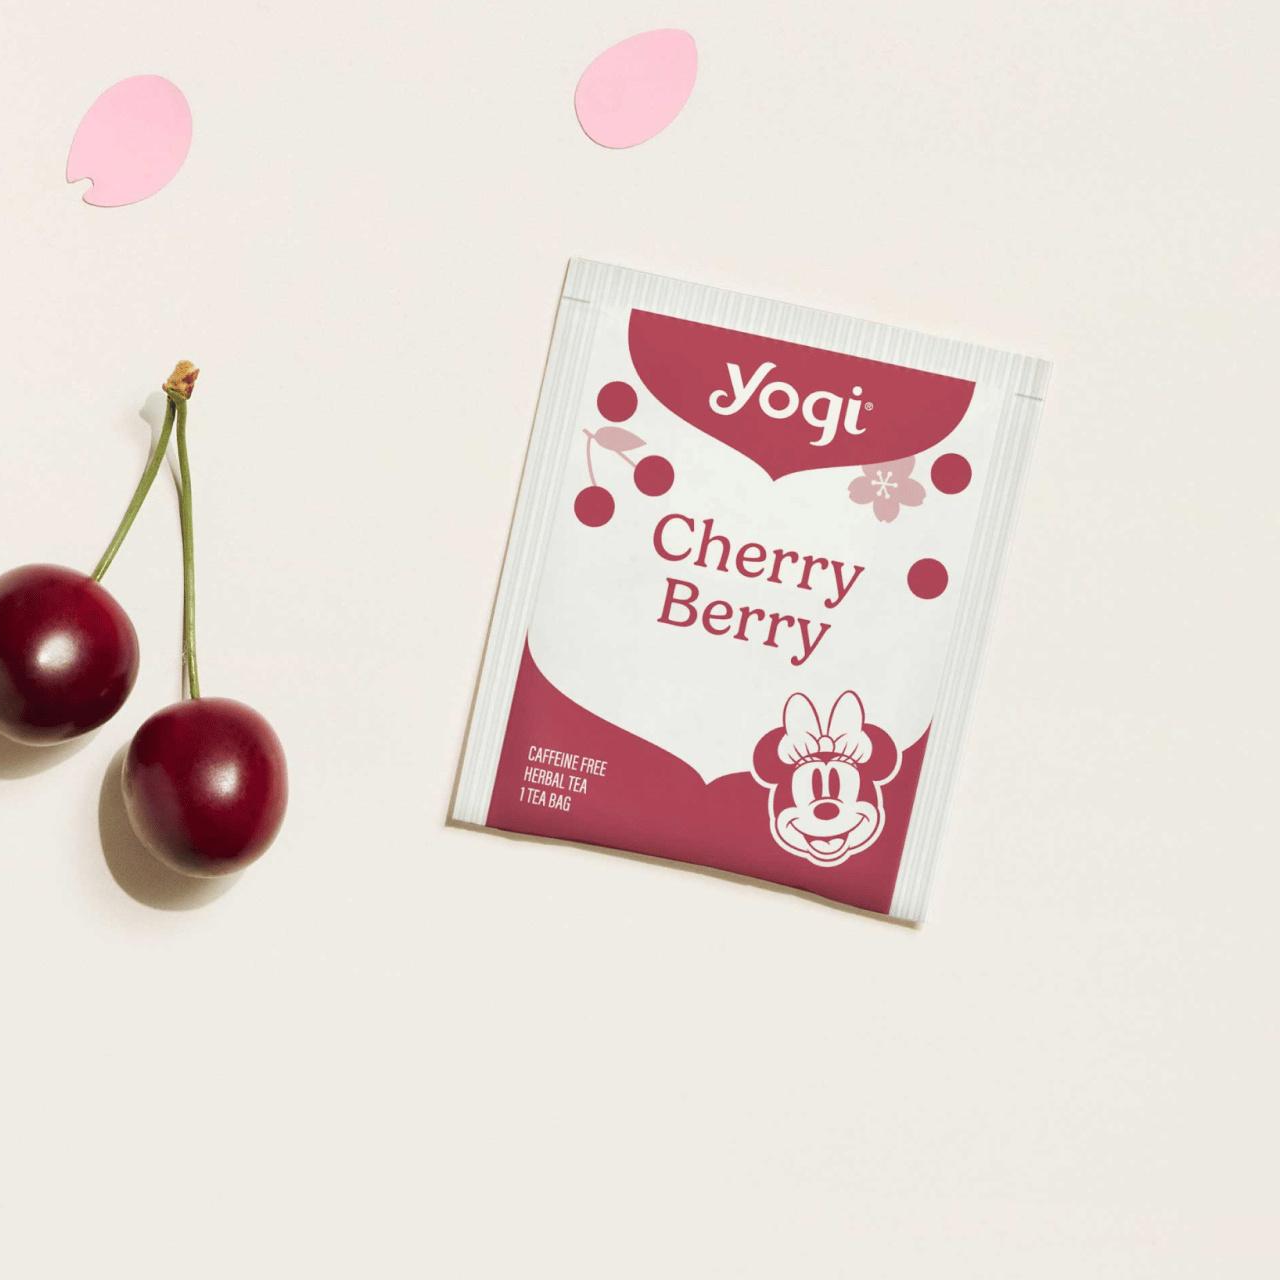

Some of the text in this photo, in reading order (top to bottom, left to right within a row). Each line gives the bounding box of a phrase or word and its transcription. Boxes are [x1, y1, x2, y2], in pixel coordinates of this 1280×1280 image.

[651, 511, 866, 609] Cherry
[656, 576, 833, 666] Berry
[527, 745, 608, 777] CAFFEINE FREE
[523, 765, 588, 795] HERBAL TEA
[519, 786, 572, 812] 1 TEA BAG
